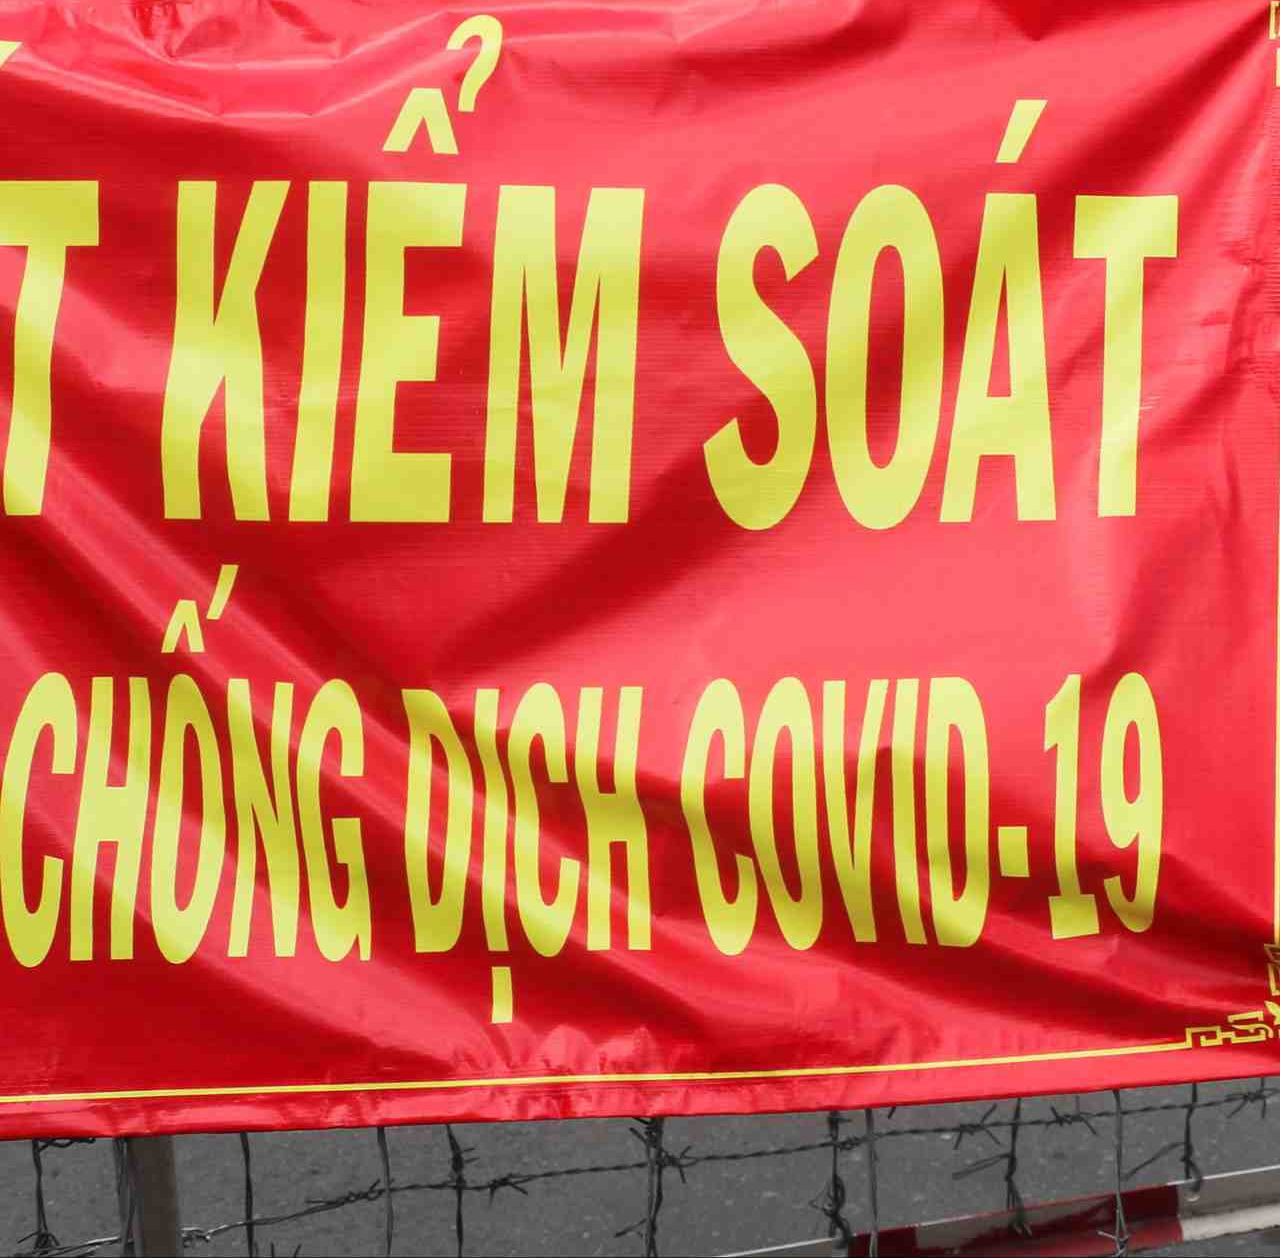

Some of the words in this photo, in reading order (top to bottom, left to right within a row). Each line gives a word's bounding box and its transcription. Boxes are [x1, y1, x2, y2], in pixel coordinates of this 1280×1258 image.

[0, 41, 100, 518] T
[161, 15, 644, 524] KIỂM
[704, 99, 1178, 530] SOÁT
[0, 565, 372, 967] CHỐNG
[402, 685, 652, 1023] DỊCH
[681, 672, 1164, 952] COVID-19
